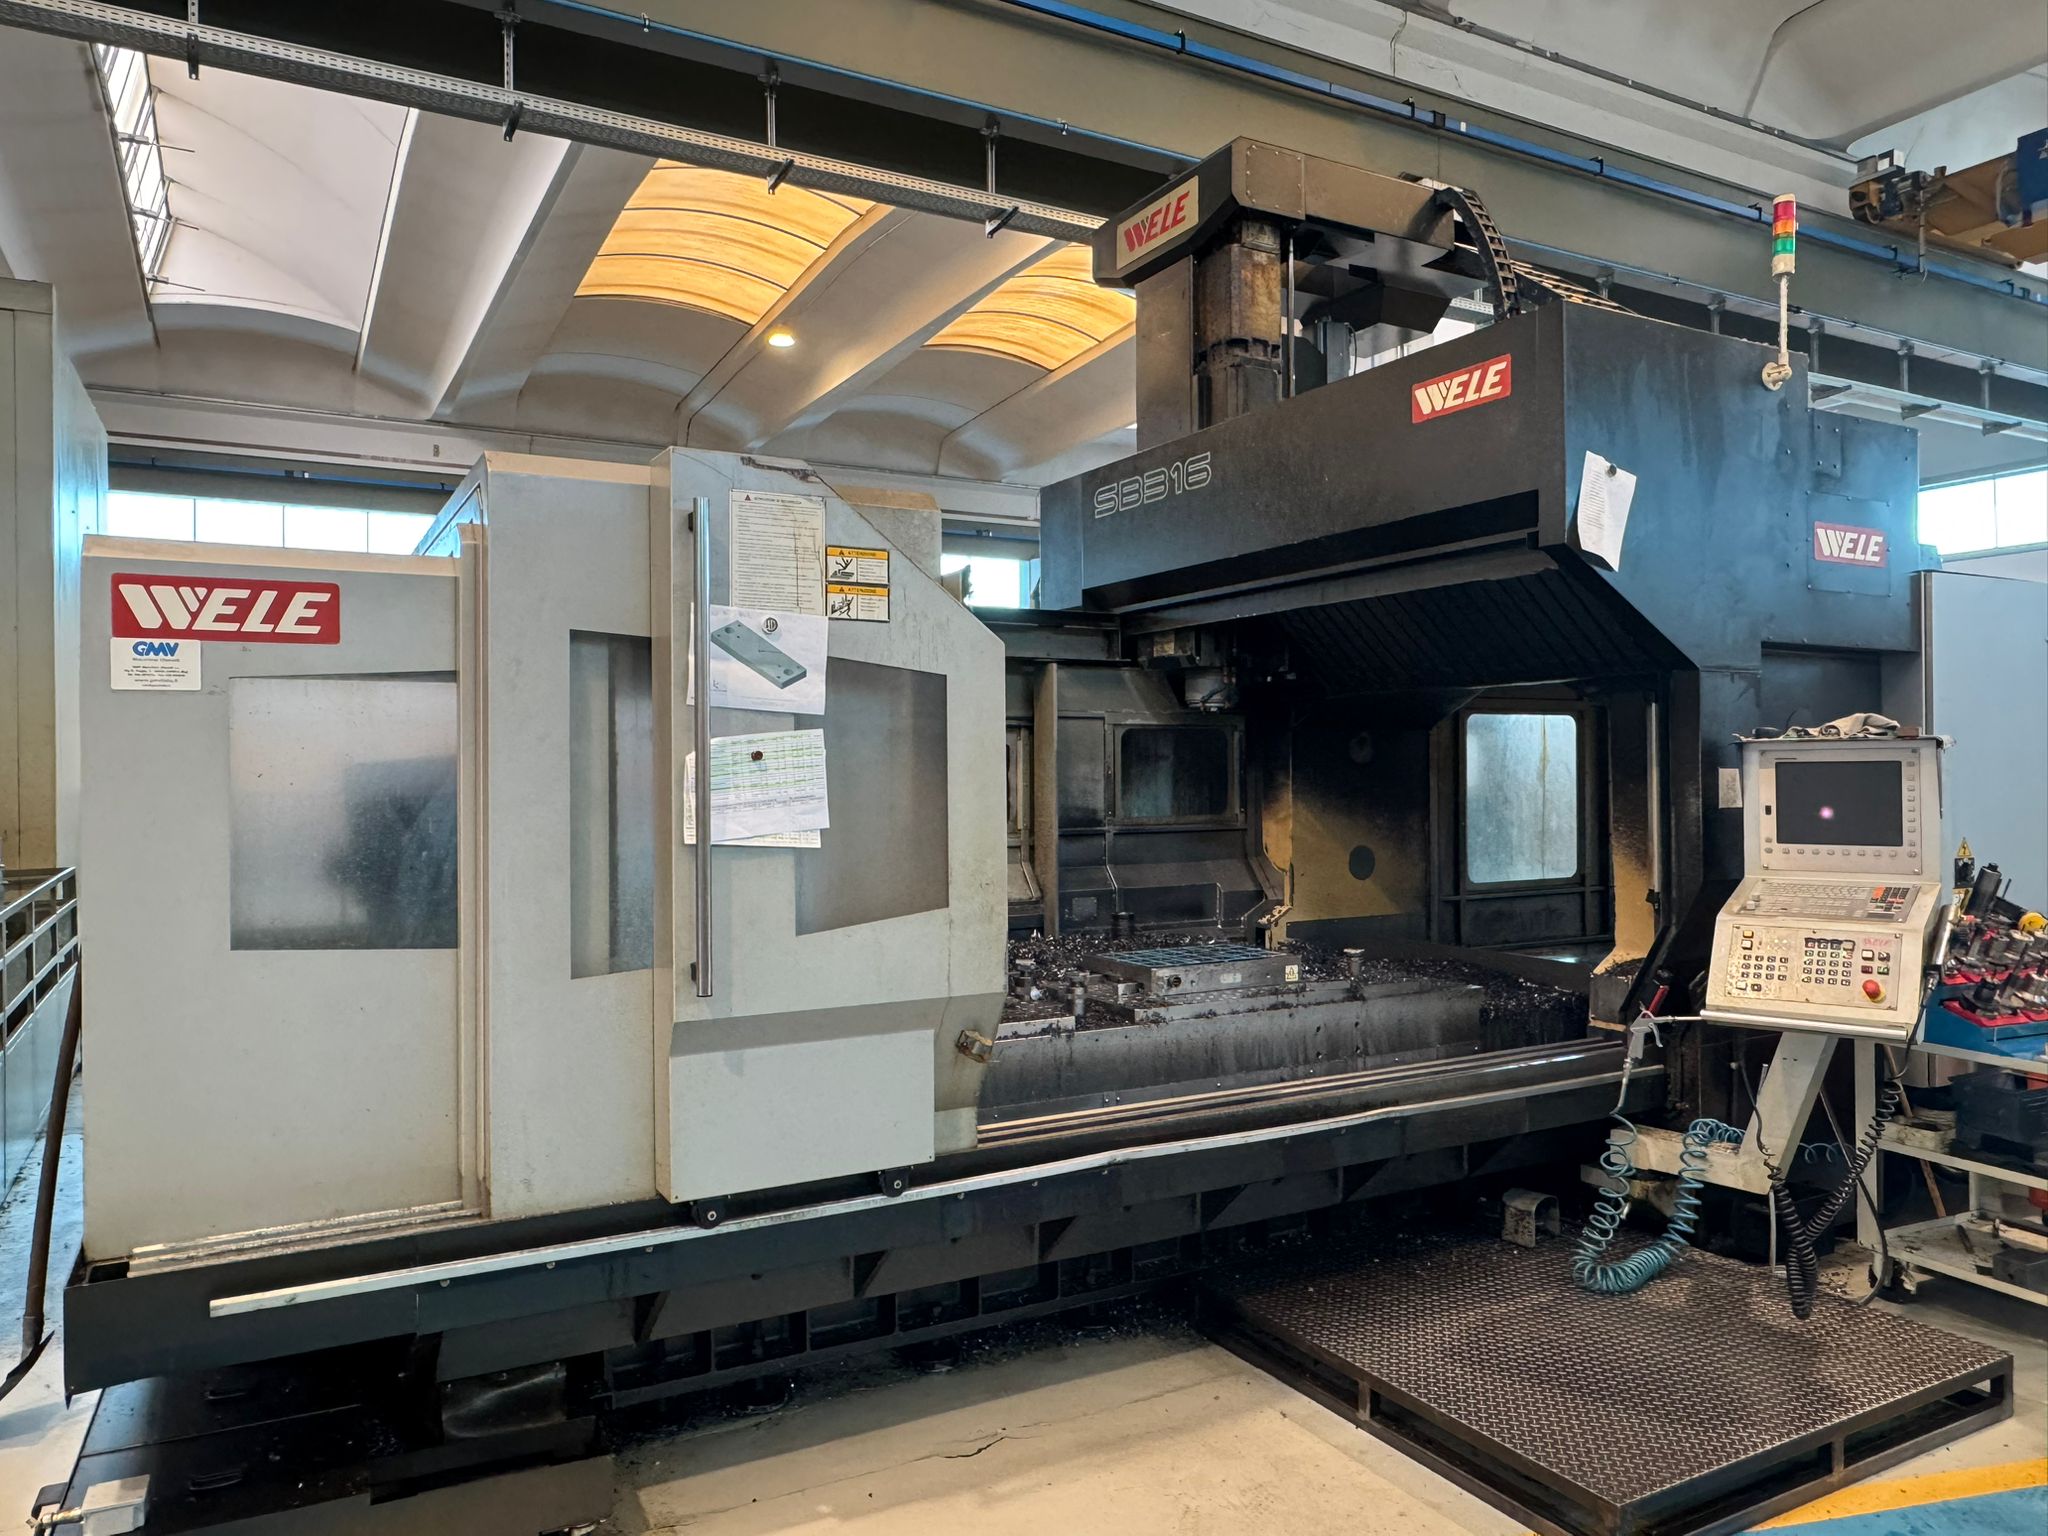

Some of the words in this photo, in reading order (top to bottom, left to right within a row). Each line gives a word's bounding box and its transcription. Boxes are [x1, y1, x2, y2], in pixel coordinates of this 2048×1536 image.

[1124, 189, 1191, 254] WELE
[1414, 360, 1508, 415] WELE
[1094, 451, 1212, 520] SB316
[1816, 528, 1884, 562] WELE
[118, 583, 332, 635] WELE
[132, 640, 179, 657] GMV
